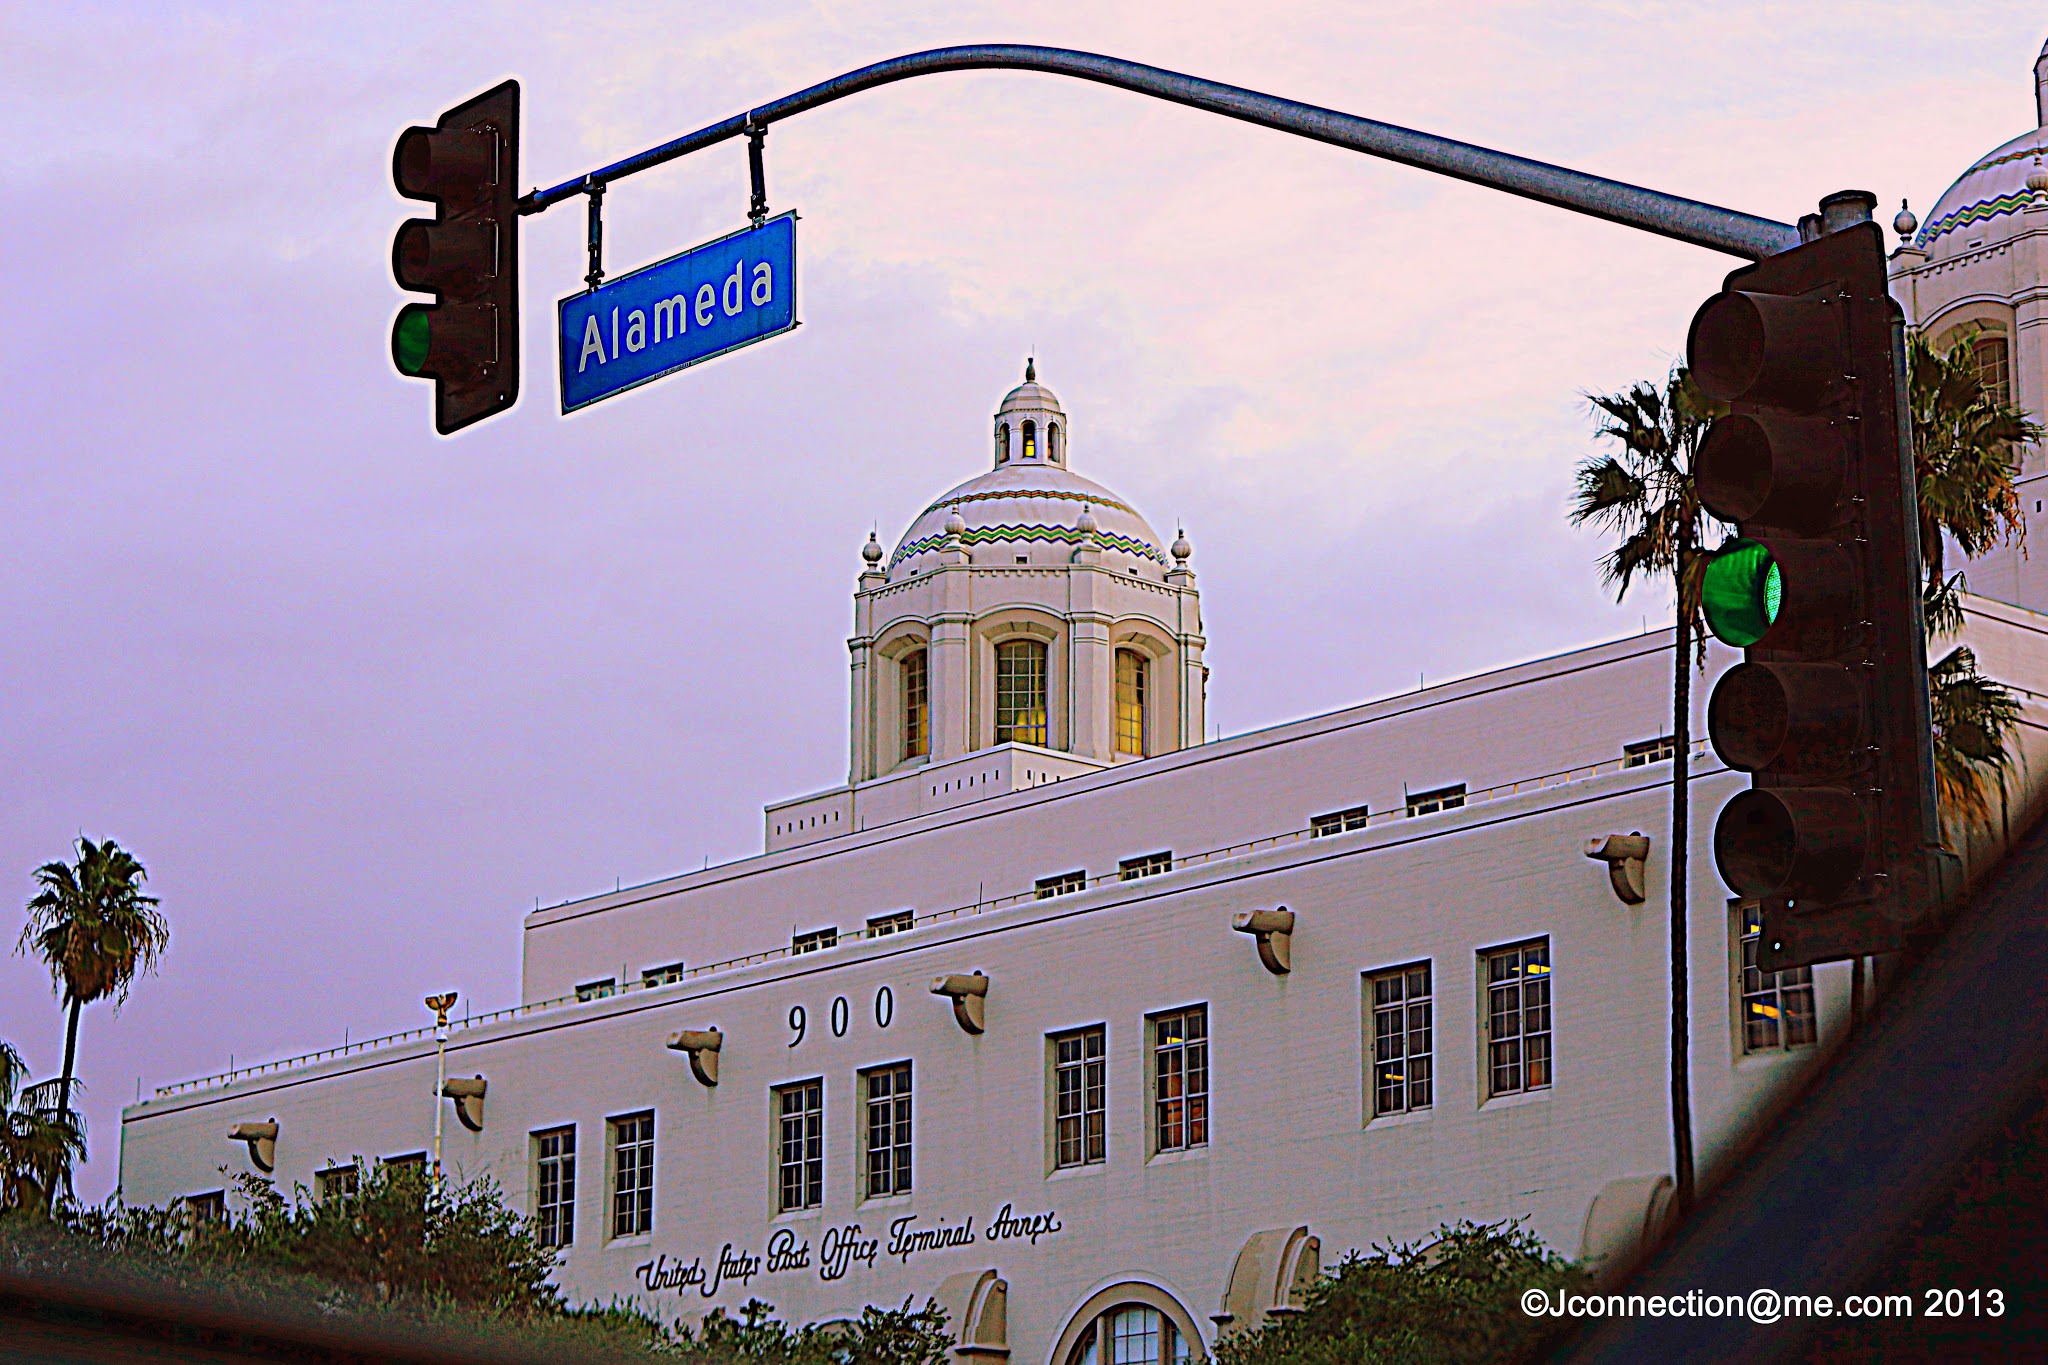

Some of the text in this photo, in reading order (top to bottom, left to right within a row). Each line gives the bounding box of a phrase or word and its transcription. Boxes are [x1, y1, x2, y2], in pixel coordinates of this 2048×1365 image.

[578, 258, 773, 373] Alameda
[788, 986, 893, 1048] 900
[636, 1203, 1061, 1297] United States Post Office Terminal Annex
